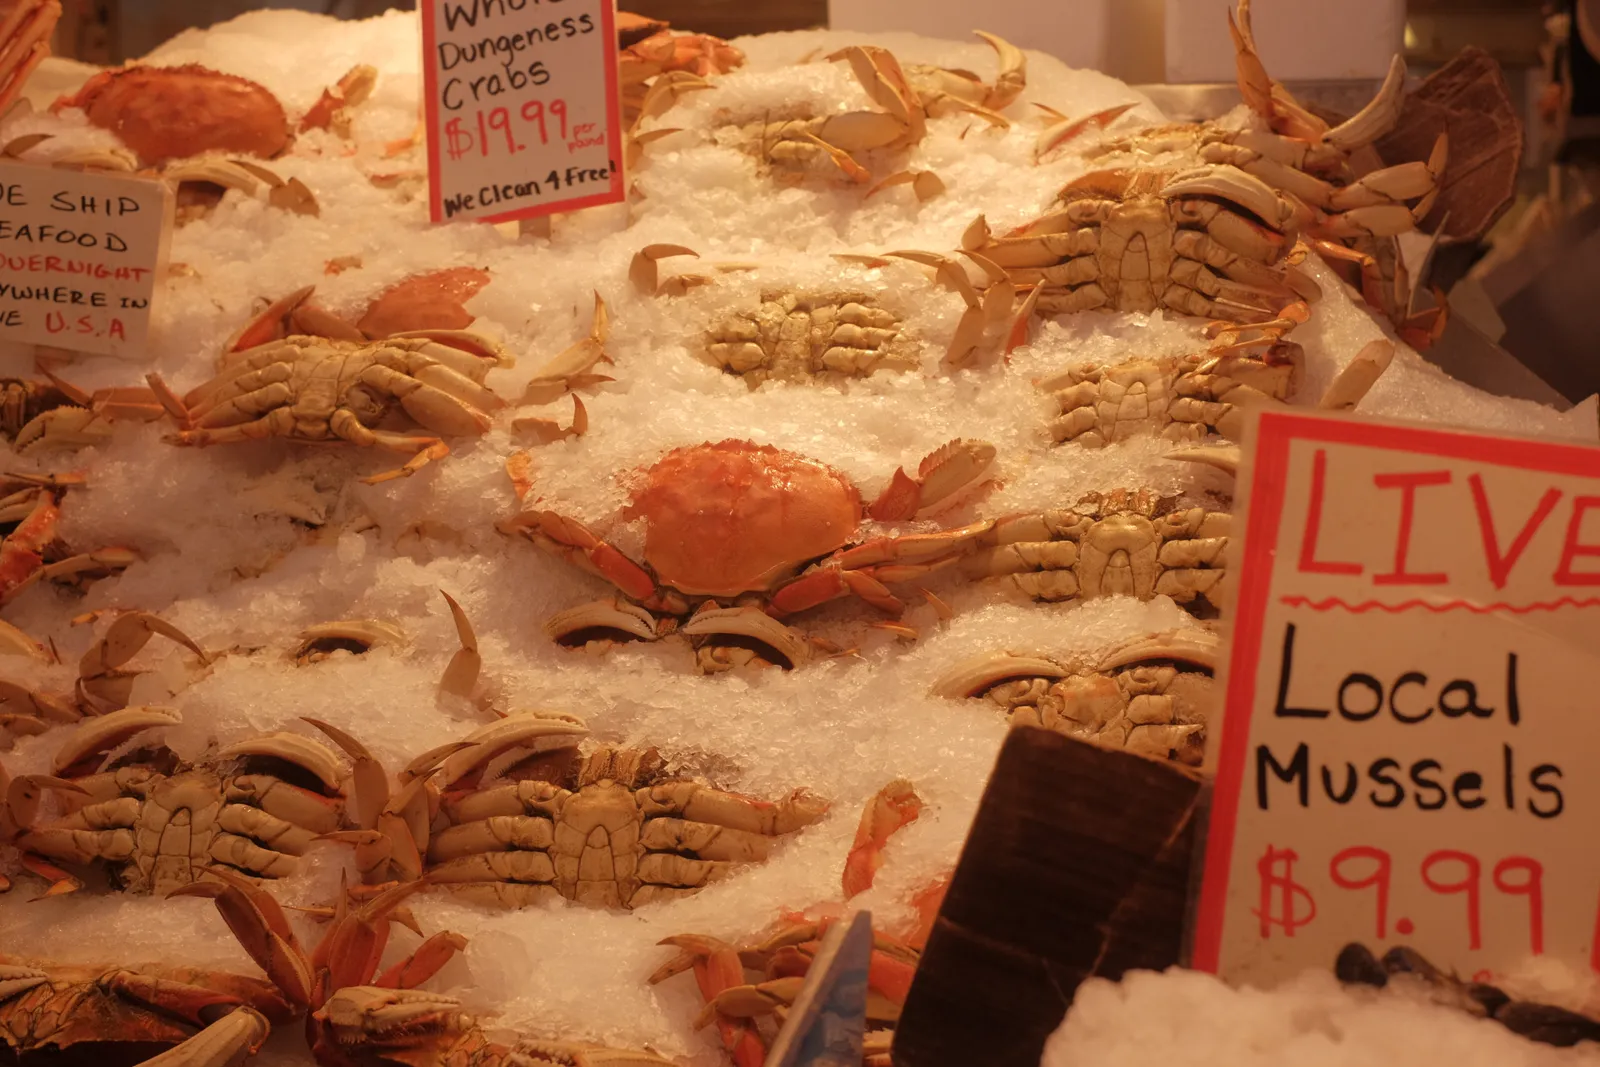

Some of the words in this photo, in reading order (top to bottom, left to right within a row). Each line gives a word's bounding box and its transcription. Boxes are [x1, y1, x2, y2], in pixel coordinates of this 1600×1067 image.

[443, 0, 565, 32] Who
[438, 13, 595, 70] Dungeness
[442, 61, 550, 110] Crabs
[444, 98, 568, 160] $19.99
[567, 131, 605, 154] pound
[573, 122, 597, 140] per
[0, 182, 28, 207] E
[50, 190, 140, 216] SHIP
[443, 192, 474, 218] We
[479, 181, 541, 206] Clean
[545, 170, 561, 190] 4
[45, 311, 126, 342] U.S.A
[120, 297, 148, 309] IN
[1296, 448, 1600, 590] LIVE
[1274, 622, 1521, 726] Local
[1256, 742, 1566, 819] Mussels
[1251, 843, 1545, 957] $9.99
